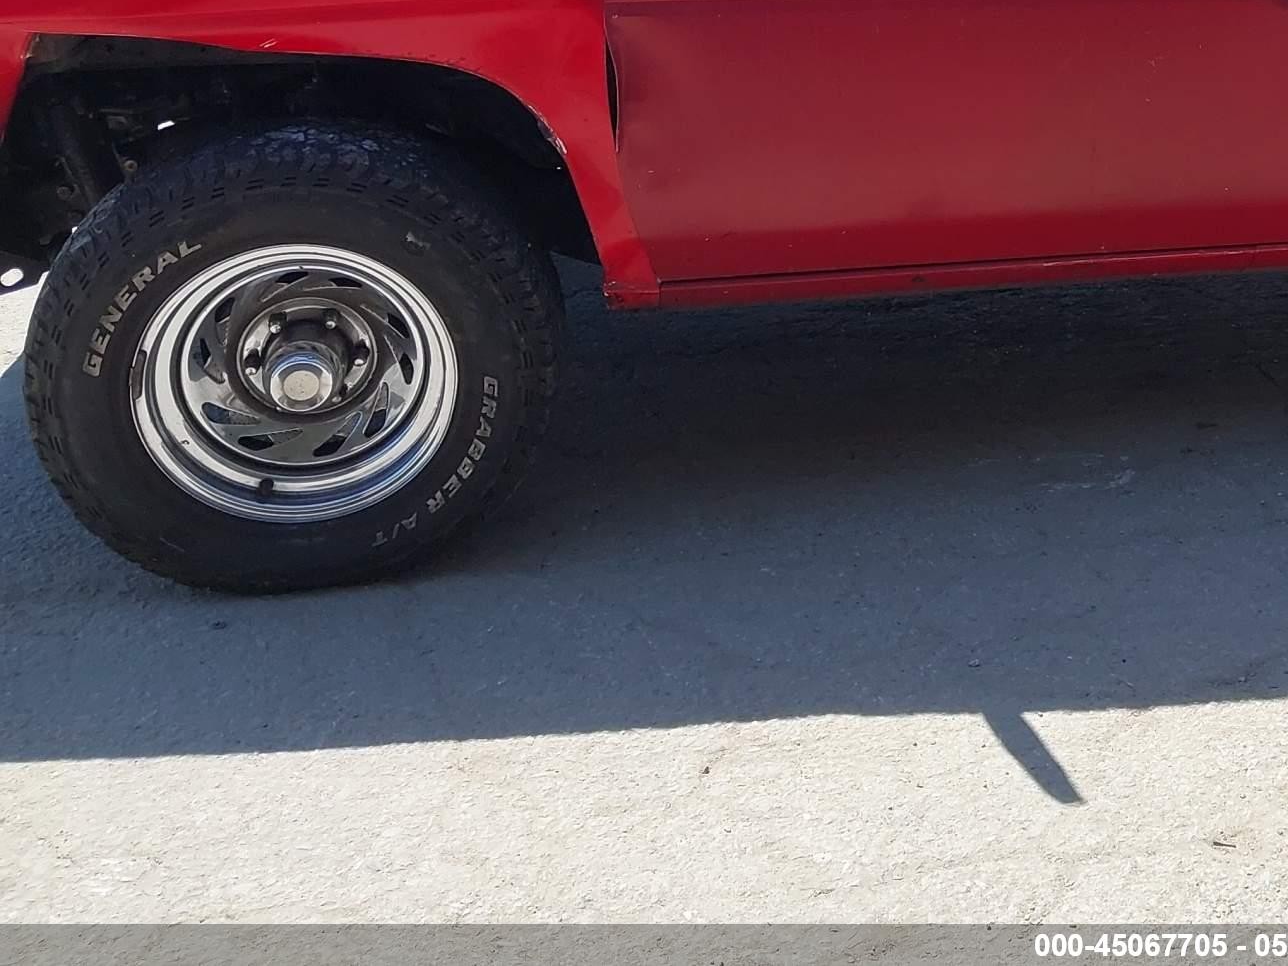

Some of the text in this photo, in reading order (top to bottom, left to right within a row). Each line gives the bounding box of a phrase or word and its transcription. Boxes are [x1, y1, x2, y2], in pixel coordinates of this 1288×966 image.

[82, 241, 202, 377] GENERAL
[371, 376, 499, 547] GRABBER A/T
